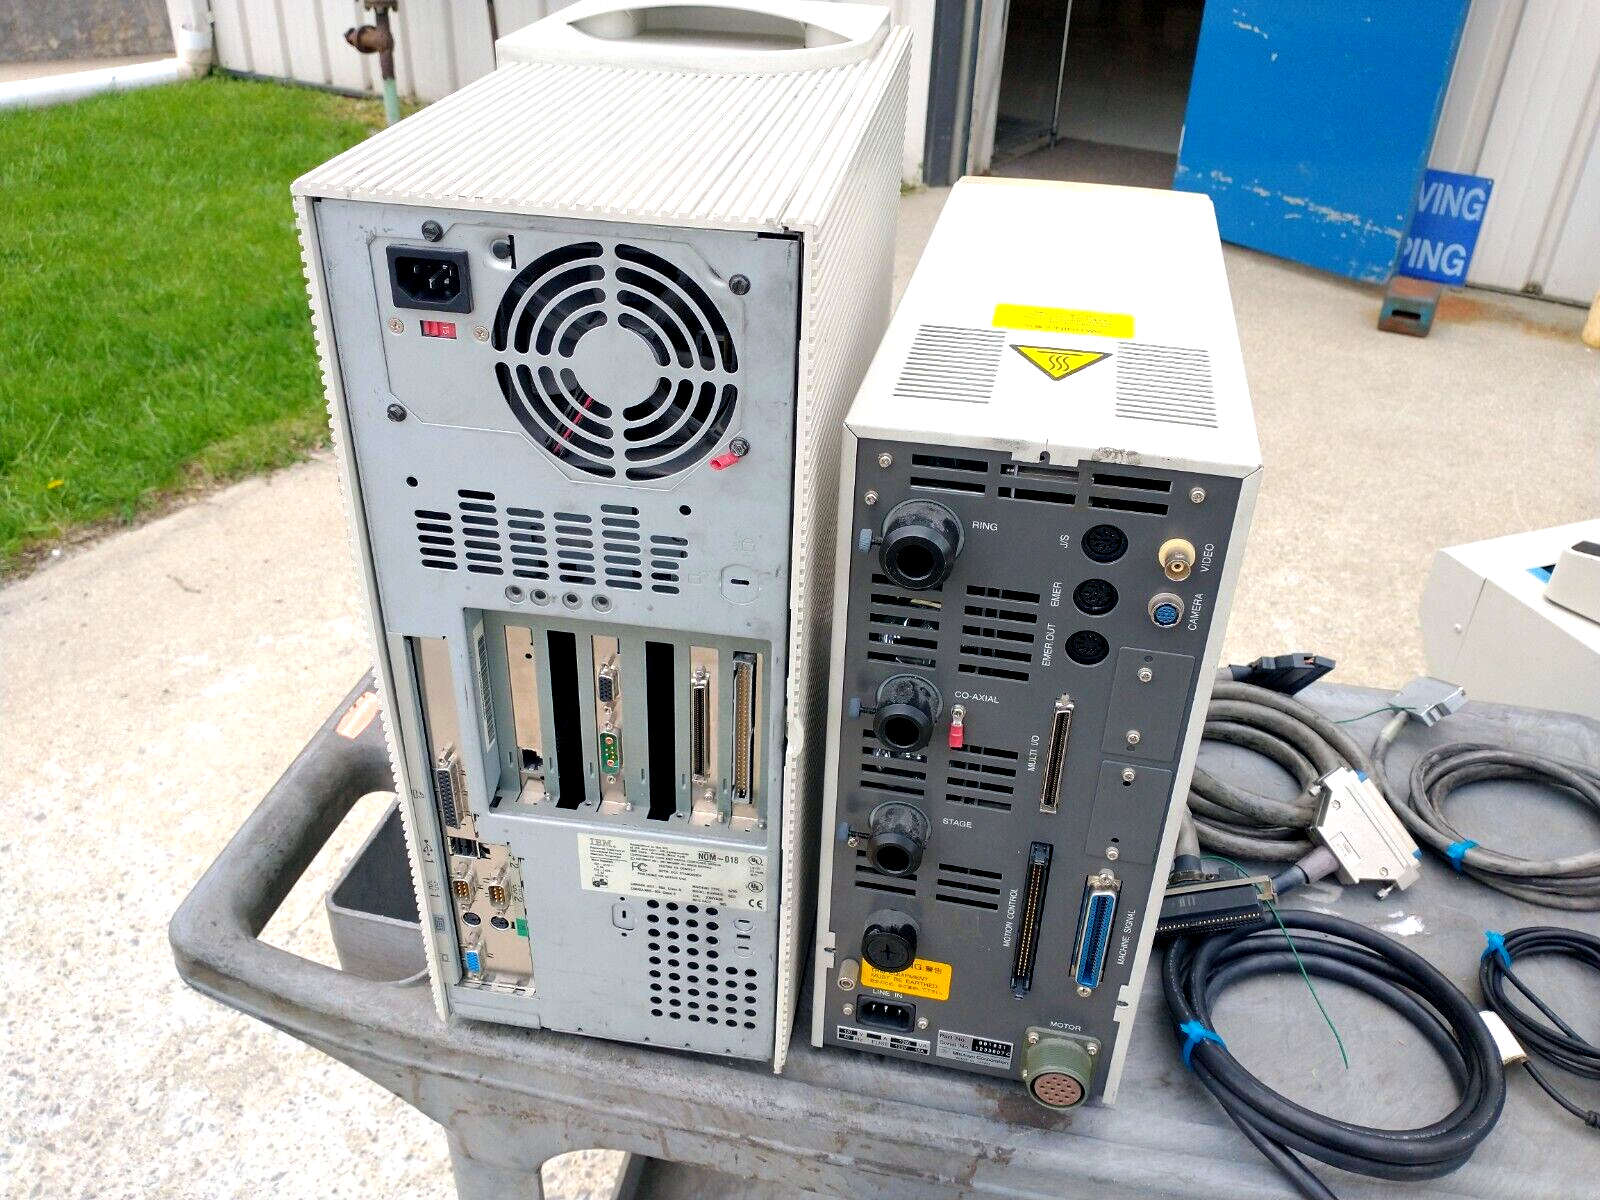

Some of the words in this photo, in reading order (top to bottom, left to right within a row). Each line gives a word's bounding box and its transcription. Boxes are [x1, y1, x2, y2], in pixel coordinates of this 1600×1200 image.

[972, 521, 998, 531] RING
[1059, 534, 1070, 548] J/S
[1200, 543, 1214, 573] VIDEO
[1051, 581, 1062, 607] EMER
[1187, 593, 1203, 631] CAMERA
[954, 690, 999, 704] CO-AXIAL
[1031, 735, 1040, 746] I/O
[1027, 749, 1037, 772] MULTI
[942, 817, 973, 829] STAGE
[589, 837, 613, 848] IBM
[1007, 888, 1018, 919] CONTROL
[1003, 921, 1013, 947] MOTION
[1117, 936, 1130, 965] MACHINE
[1124, 909, 1136, 933] SIGNAL
[872, 988, 891, 997] LINE
[1050, 1021, 1081, 1031] MOTOR
